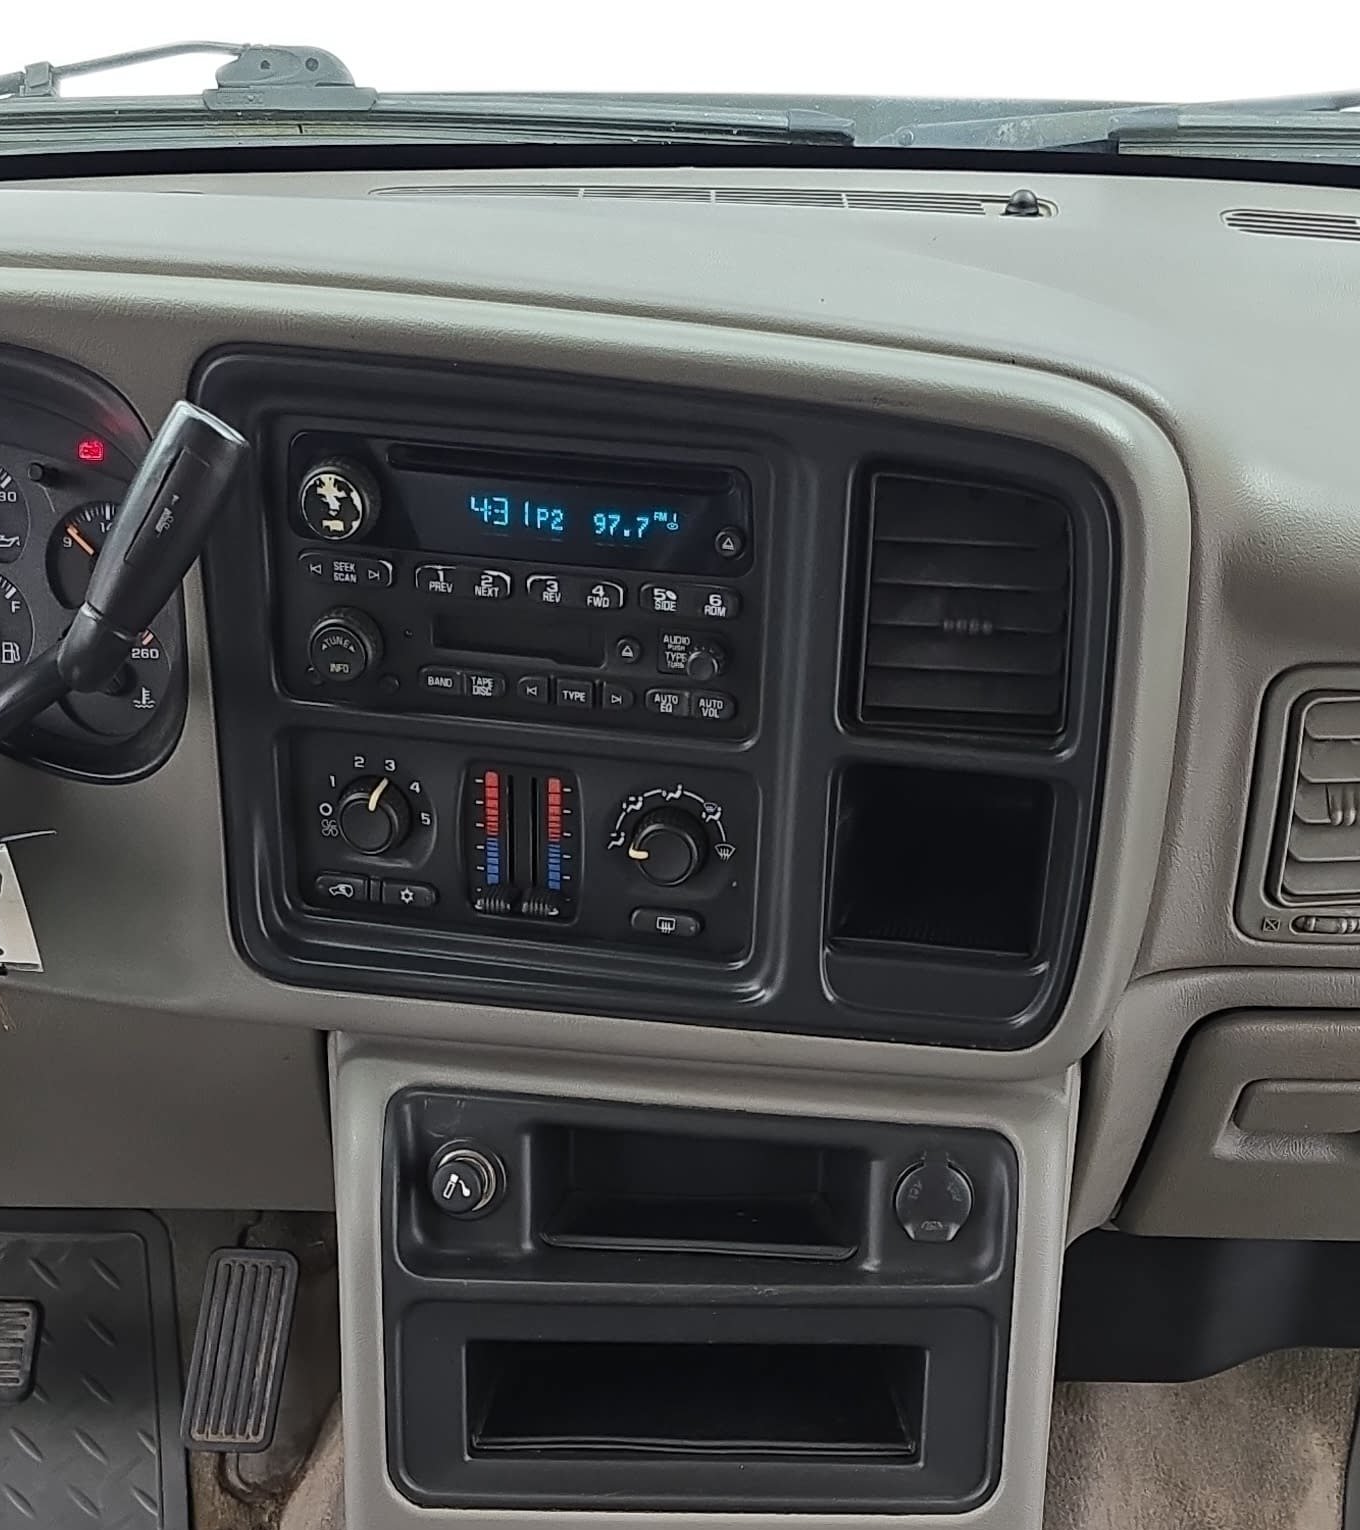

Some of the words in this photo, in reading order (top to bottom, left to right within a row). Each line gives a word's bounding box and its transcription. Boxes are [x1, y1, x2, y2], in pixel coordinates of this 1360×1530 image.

[593, 513, 649, 538] 97.7
[63, 537, 72, 547] 9
[333, 561, 356, 572] SEEK
[333, 572, 357, 584] SCAN
[480, 574, 493, 587] 2
[429, 581, 453, 593] PREV
[474, 585, 500, 598] NEXT
[546, 580, 558, 593] 3
[592, 584, 605, 597] 4
[543, 591, 561, 603] REV
[653, 588, 666, 601] 5
[708, 594, 722, 606] 6
[11, 601, 20, 612] F
[587, 596, 610, 608] FWD
[654, 600, 677, 612] SIDE
[325, 636, 350, 649] TUNE
[663, 634, 690, 645] AUDIO
[131, 648, 159, 659] 260
[427, 676, 453, 688] BAND
[471, 676, 493, 688] TAPE
[472, 686, 492, 697] DISC
[562, 690, 586, 702] TYPE
[654, 694, 678, 704] AUTO
[699, 698, 723, 710] AUTO
[701, 707, 720, 718] VOL
[354, 756, 365, 768] 2
[385, 760, 396, 771] 3
[330, 775, 336, 787] 1
[410, 782, 420, 793] 4
[421, 812, 431, 825] 5
